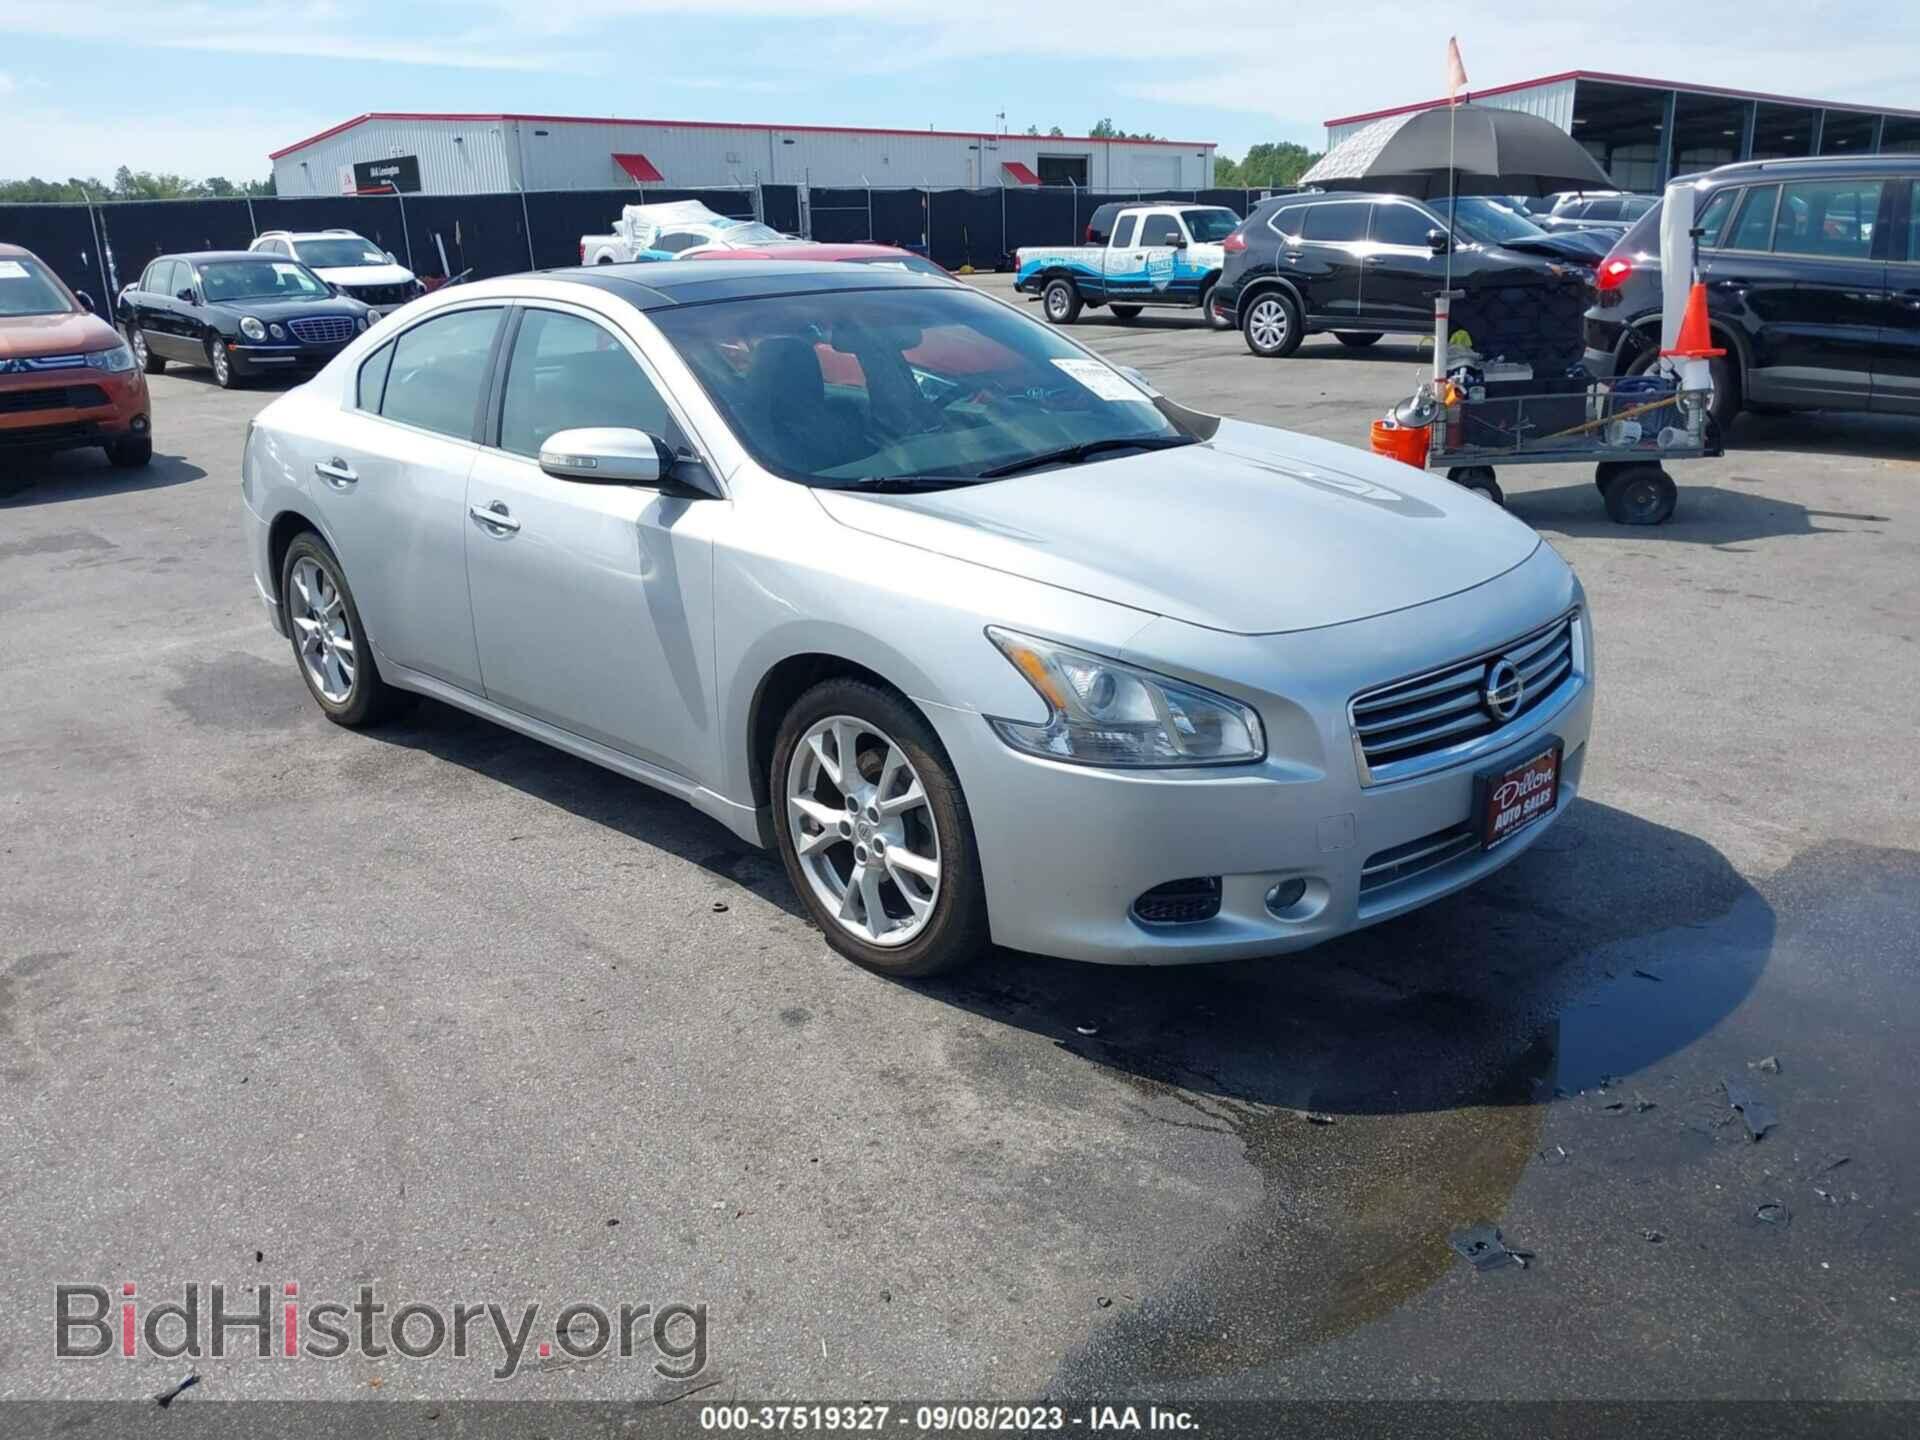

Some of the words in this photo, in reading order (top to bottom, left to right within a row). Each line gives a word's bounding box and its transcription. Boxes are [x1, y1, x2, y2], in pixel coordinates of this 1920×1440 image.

[1493, 768, 1552, 809] Dillon
[1495, 804, 1521, 830] AUTO
[1523, 788, 1552, 814] SALES
